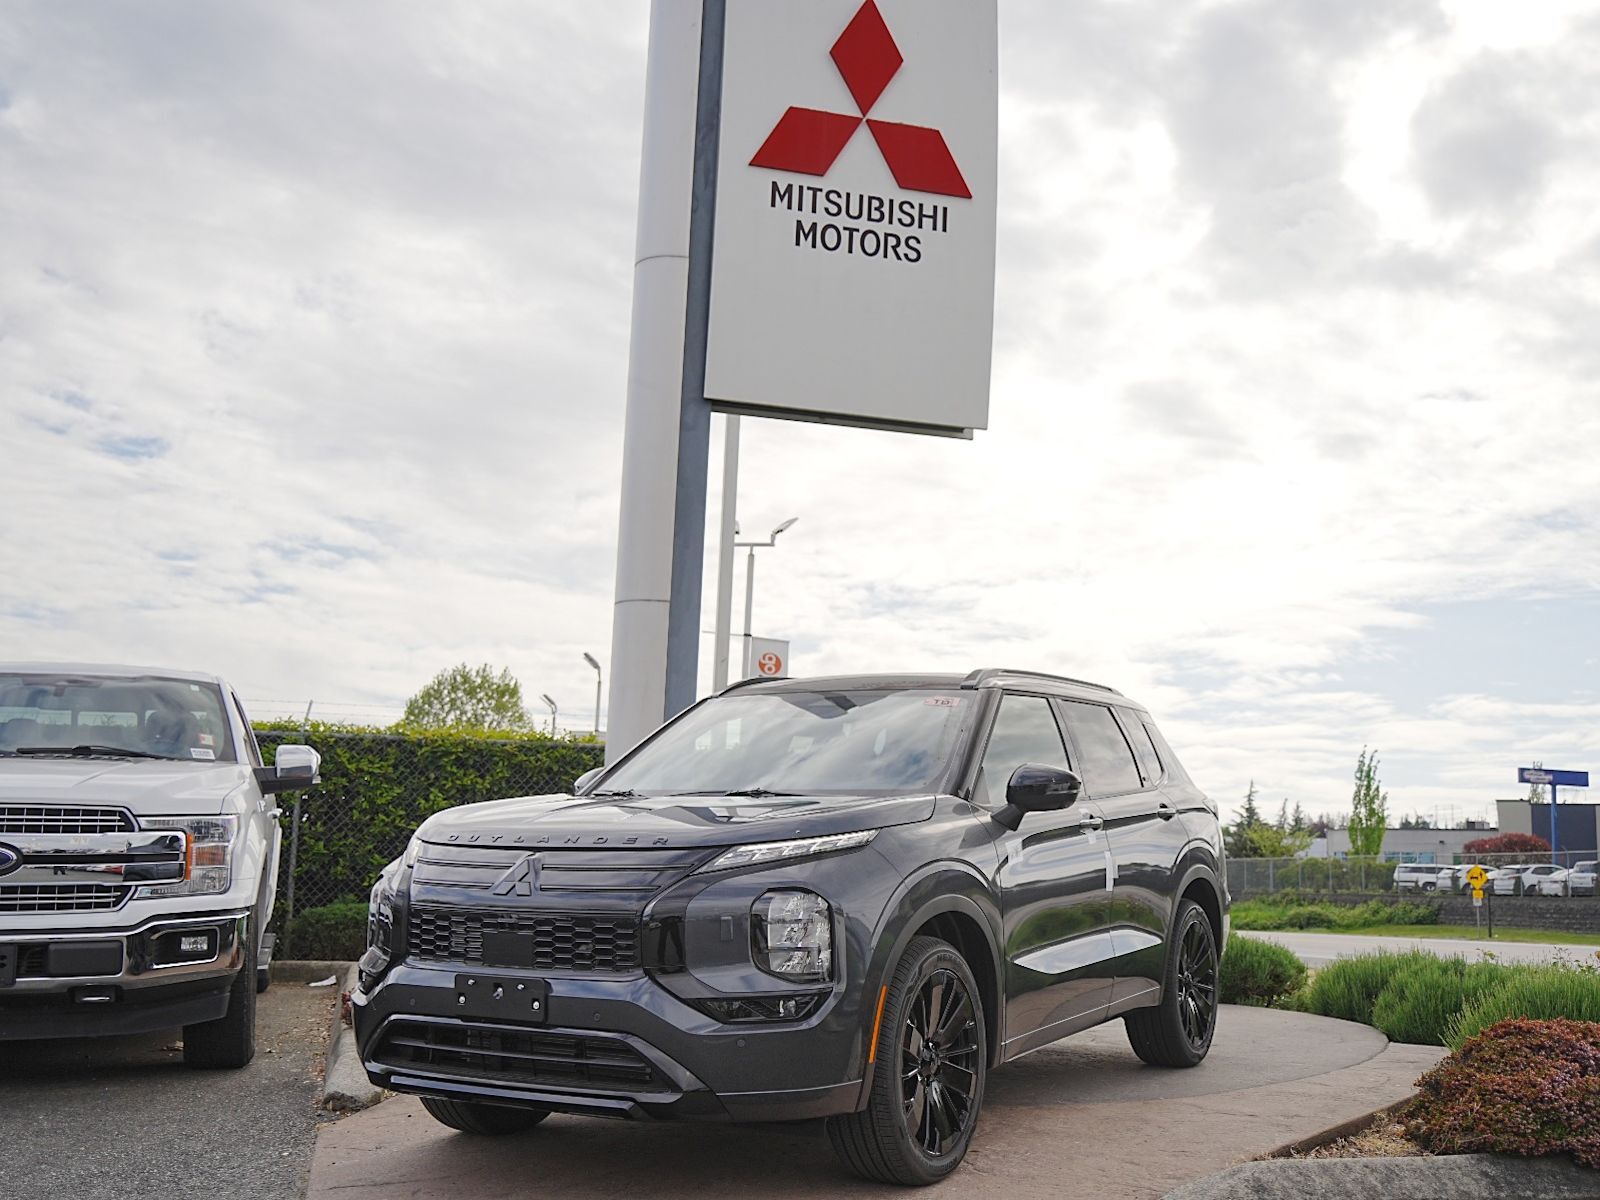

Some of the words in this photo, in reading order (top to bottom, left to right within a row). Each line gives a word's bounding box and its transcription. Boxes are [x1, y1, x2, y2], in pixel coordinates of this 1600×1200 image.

[770, 180, 948, 233] MITSUBISHI
[794, 219, 922, 263] MOTORS
[447, 834, 669, 846] OUTLANDER
